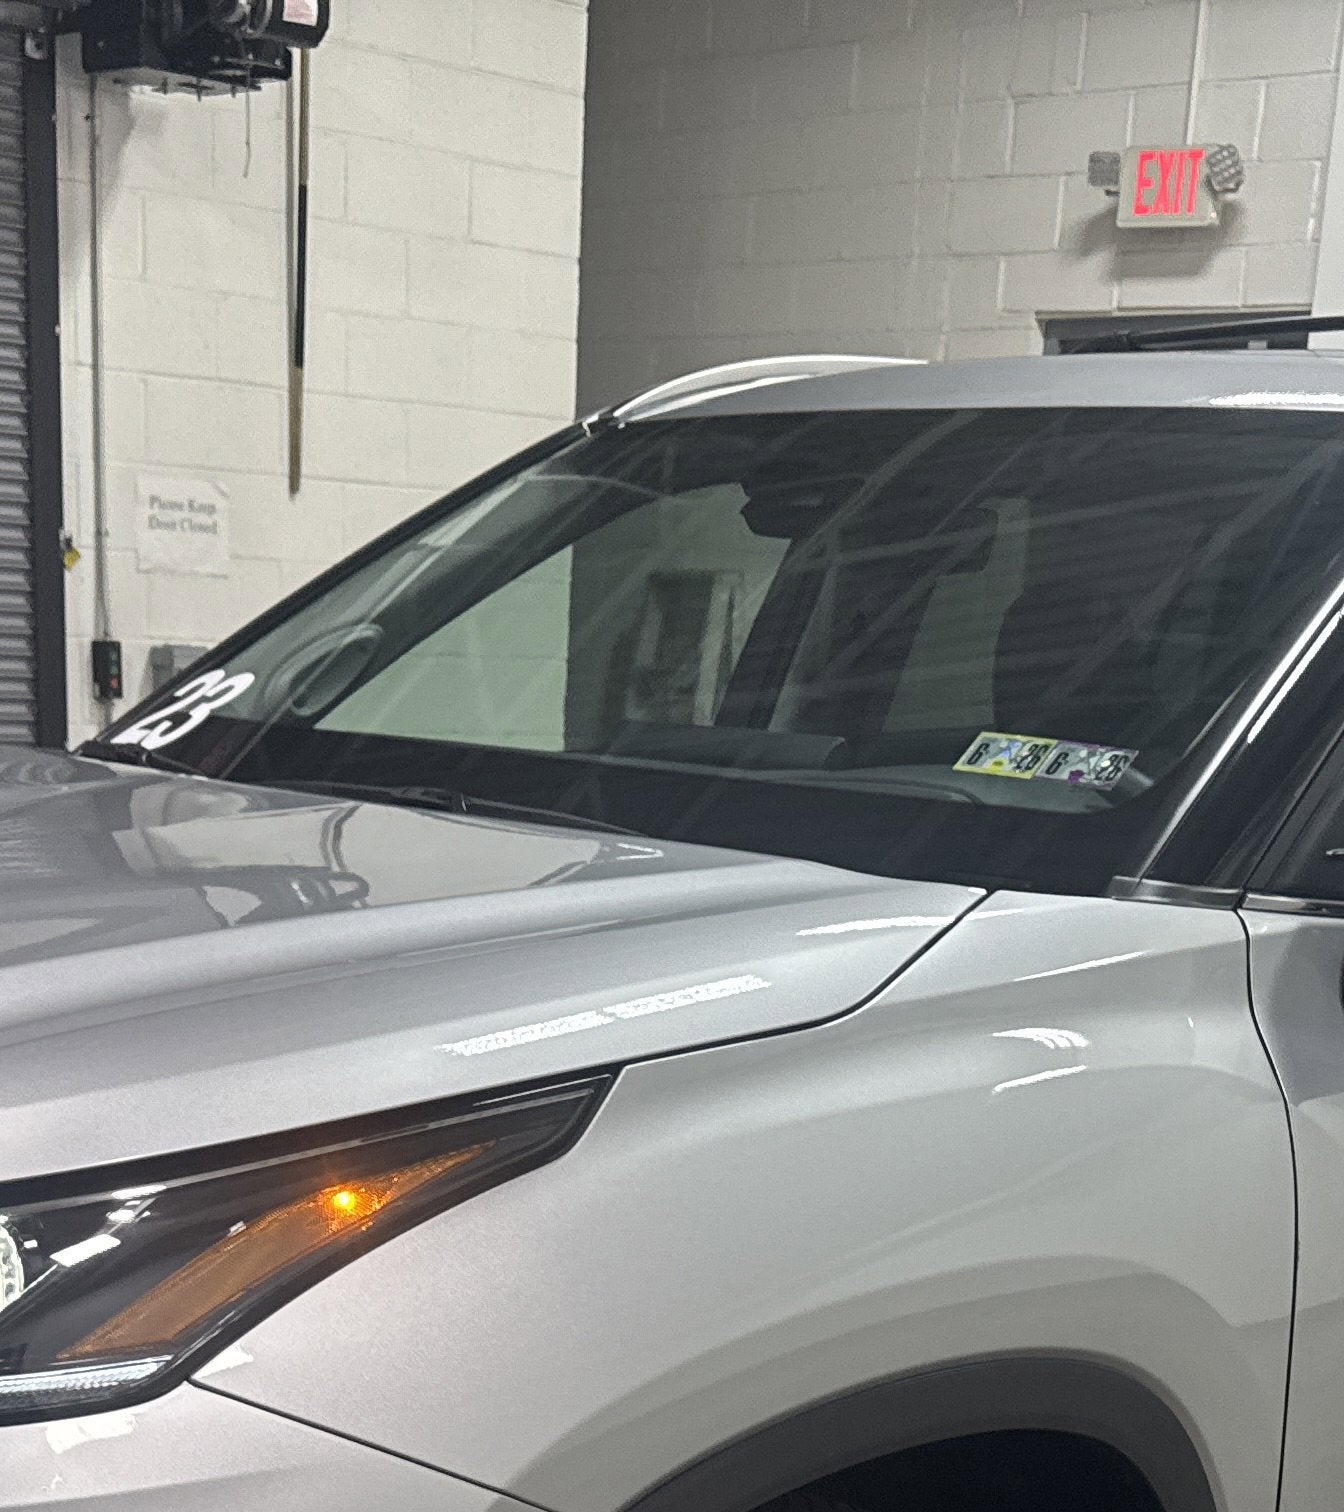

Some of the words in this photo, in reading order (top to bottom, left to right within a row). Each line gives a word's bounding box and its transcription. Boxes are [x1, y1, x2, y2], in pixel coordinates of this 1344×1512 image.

[1132, 149, 1207, 215] EXIT
[109, 669, 255, 750] 23
[967, 743, 991, 765] 6
[1015, 743, 1050, 772] 26
[1045, 752, 1069, 776] 6
[1094, 753, 1130, 781] 26
